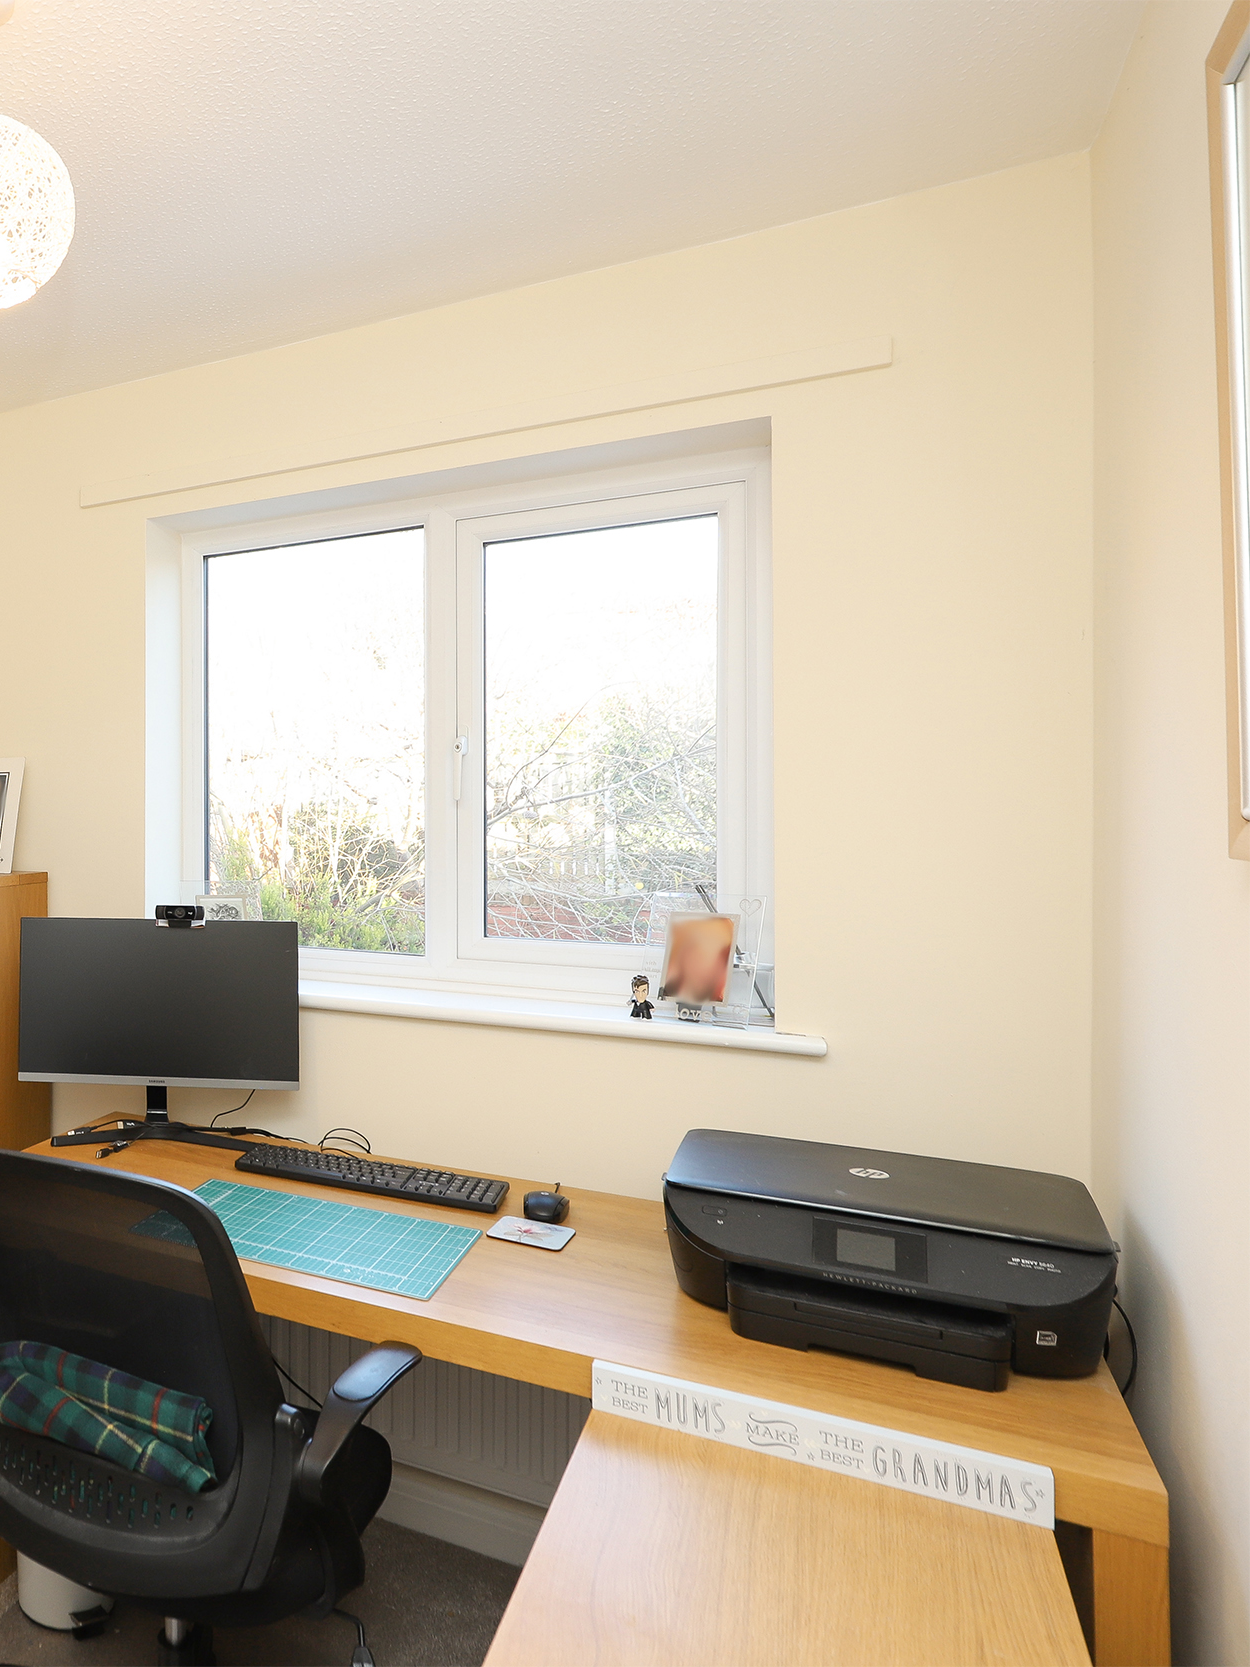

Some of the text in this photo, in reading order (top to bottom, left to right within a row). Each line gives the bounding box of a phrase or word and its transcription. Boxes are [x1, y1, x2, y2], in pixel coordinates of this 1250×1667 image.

[675, 1003, 713, 1022] love
[1021, 1258, 1038, 1266] ENVY
[611, 1379, 1039, 1513] THE BEST MUMS MAKE THE BEST GRANDMAS
